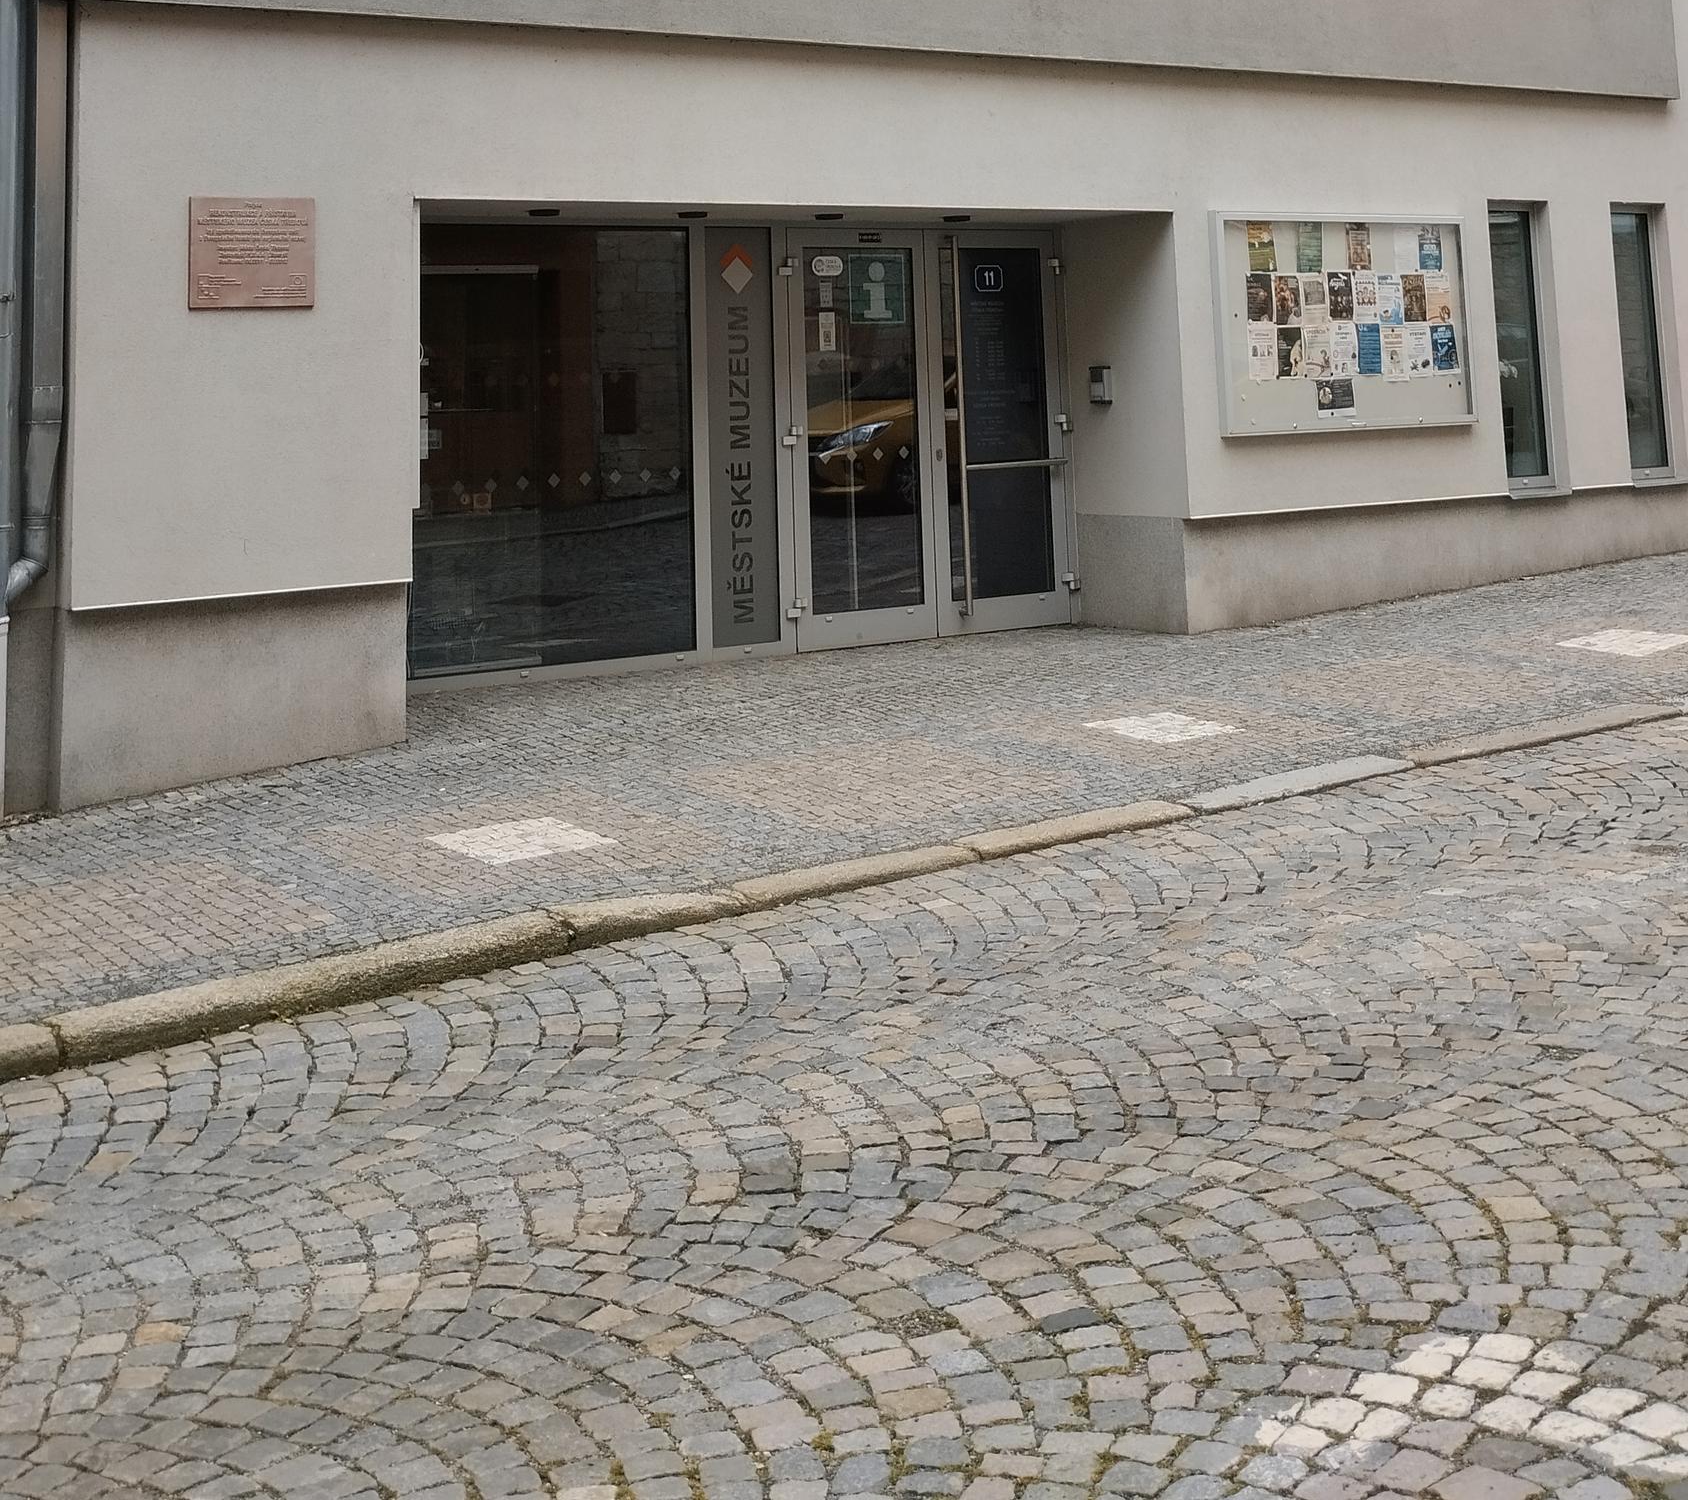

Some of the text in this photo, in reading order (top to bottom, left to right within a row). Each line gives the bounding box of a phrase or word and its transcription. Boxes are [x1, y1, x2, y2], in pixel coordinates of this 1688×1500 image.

[983, 270, 995, 286] 11
[725, 306, 755, 624] MĚSTSKÉ MUZEUM
